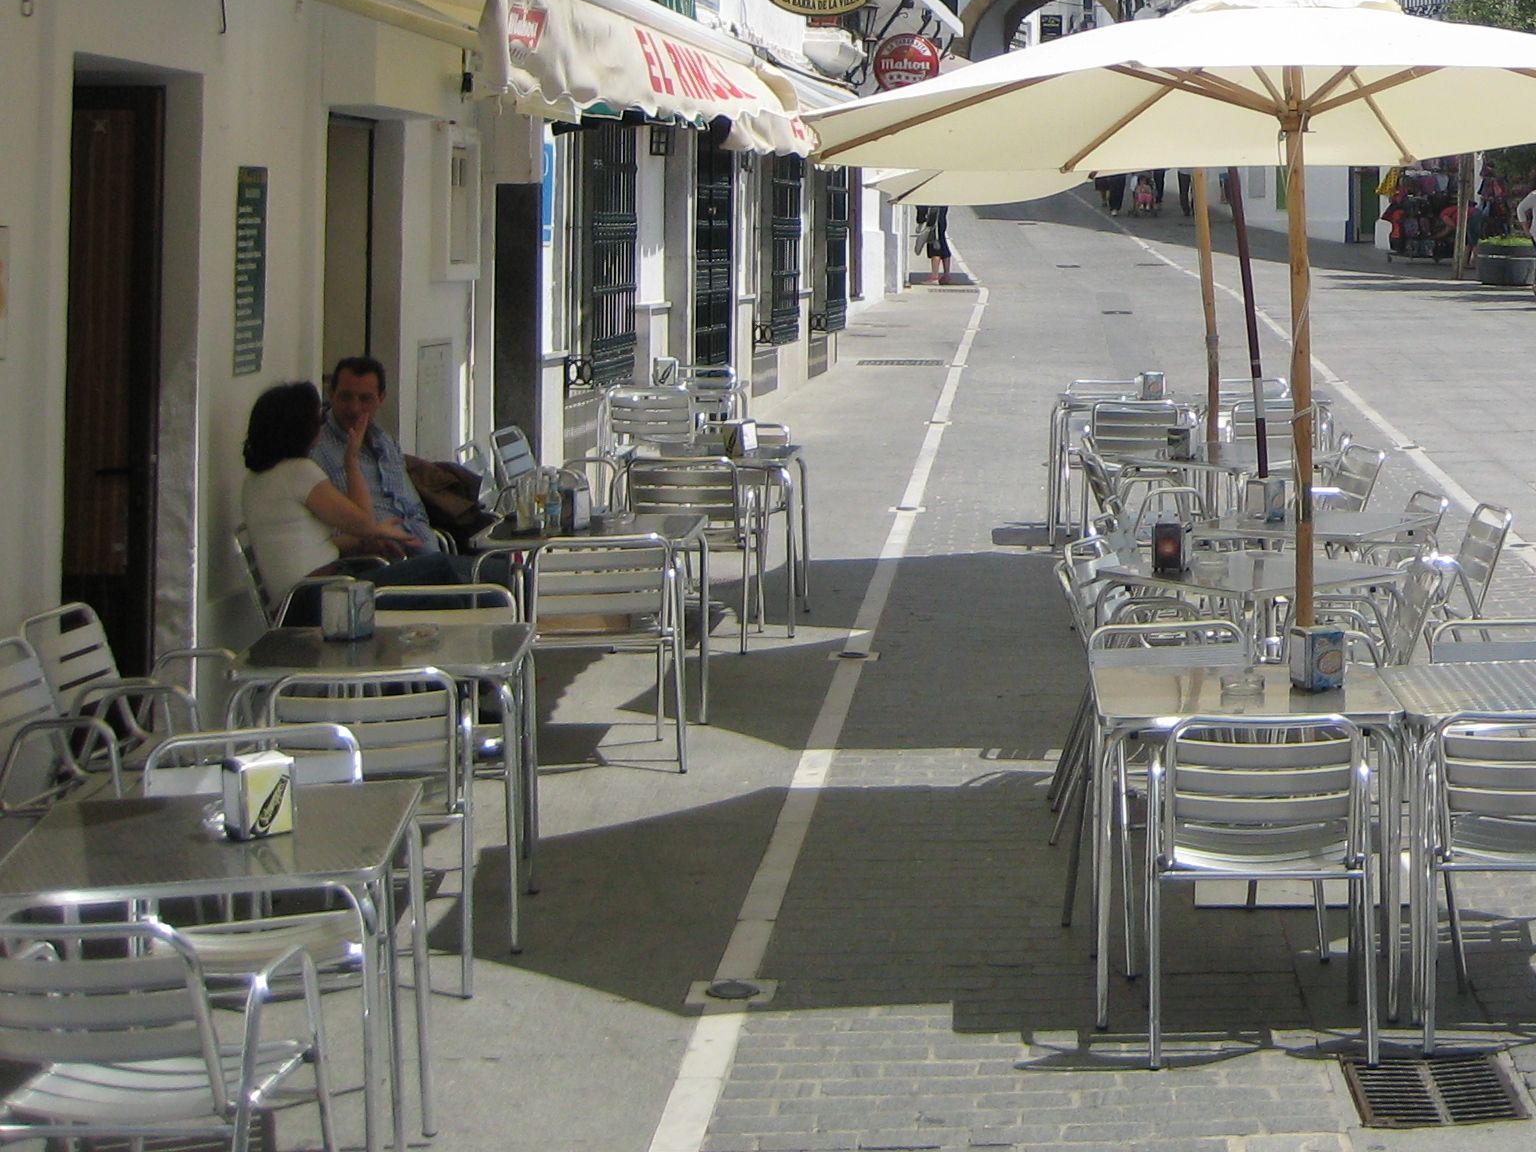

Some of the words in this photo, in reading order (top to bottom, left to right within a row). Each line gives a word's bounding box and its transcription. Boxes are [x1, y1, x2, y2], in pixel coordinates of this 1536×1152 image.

[817, 0, 826, 10] DE
[828, 0, 837, 9] LA
[634, 27, 674, 96] EL
[881, 58, 930, 71] Mahou
